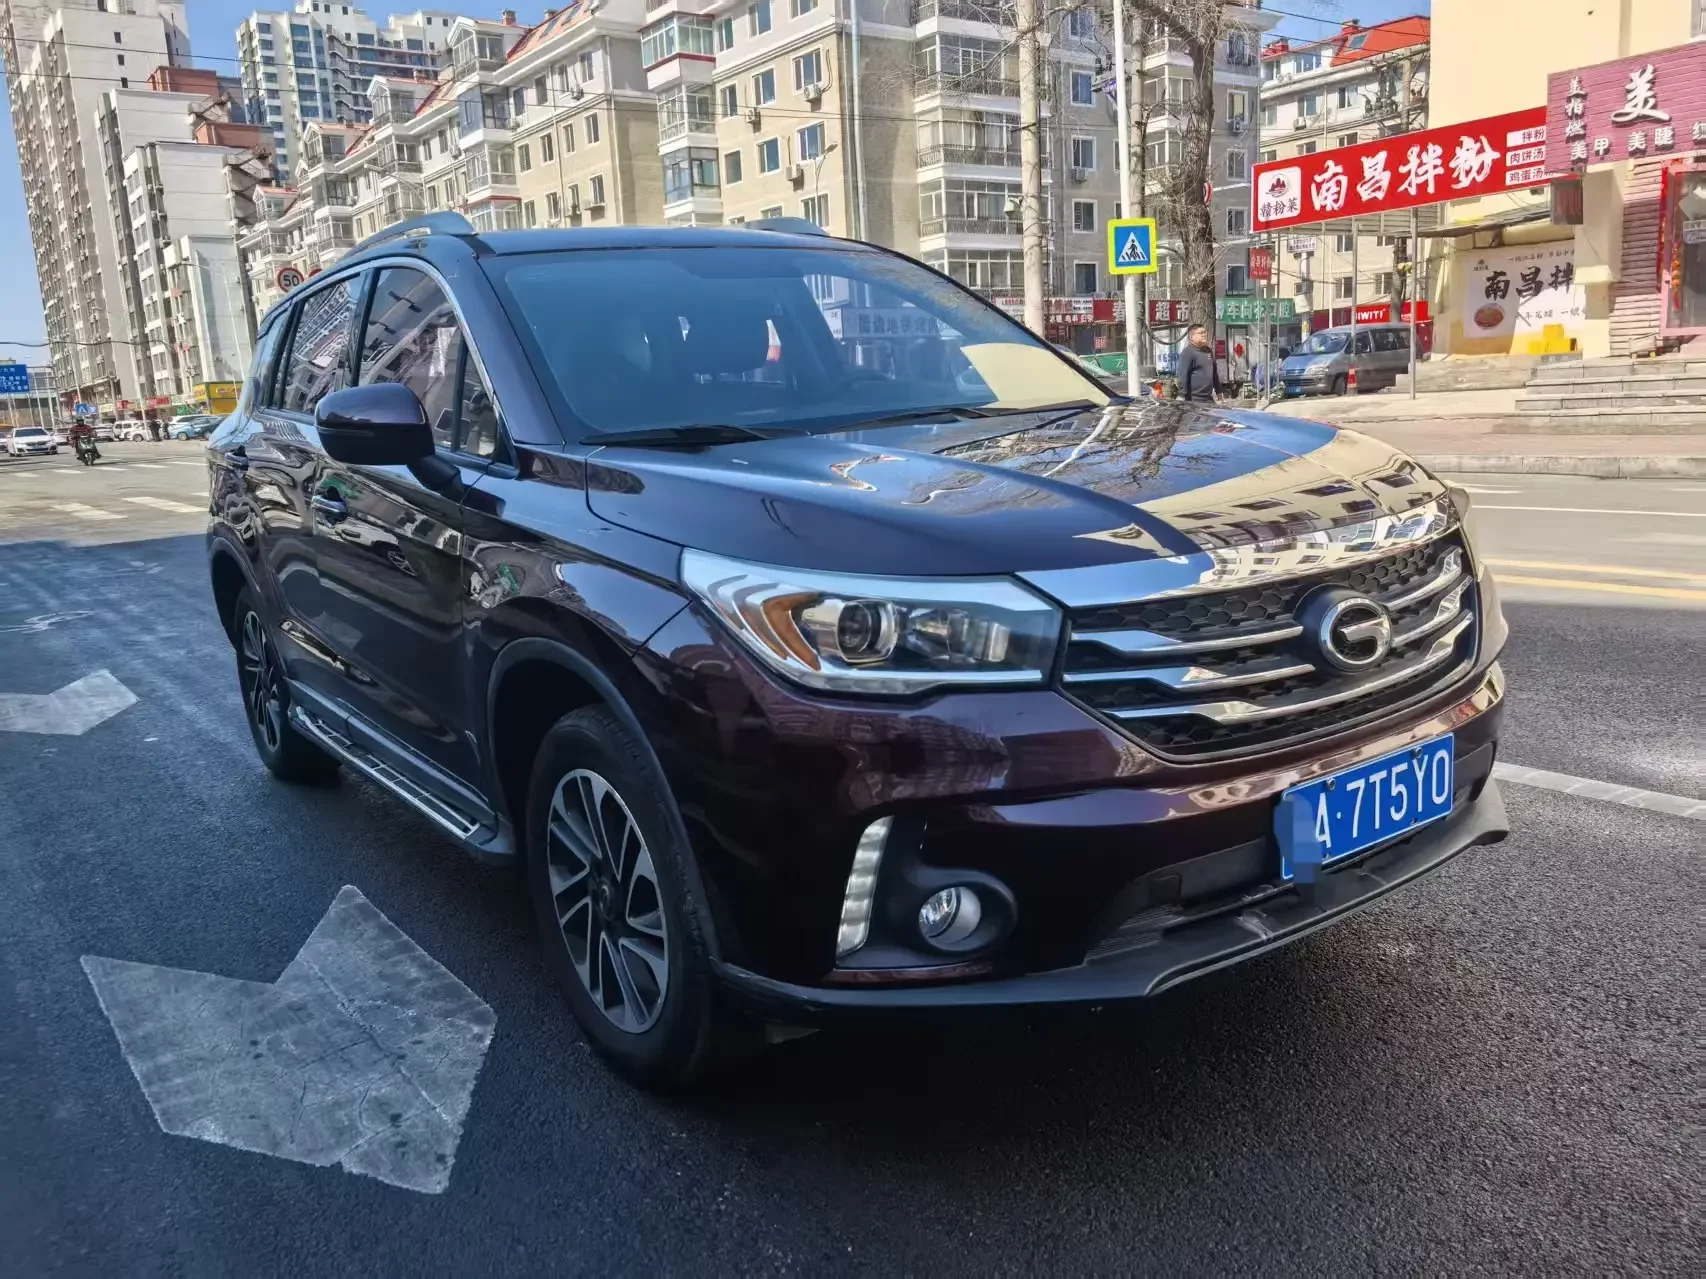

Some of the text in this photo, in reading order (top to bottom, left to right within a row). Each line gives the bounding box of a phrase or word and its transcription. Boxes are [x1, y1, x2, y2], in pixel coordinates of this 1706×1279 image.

[1612, 64, 1671, 123] 美
[1521, 128, 1545, 143] 拌粉
[1311, 135, 1501, 212] 南昌拌粉
[1510, 147, 1544, 164] 肉饼汤
[284, 275, 300, 287] 50
[1313, 749, 1451, 850] A·7T5Y0
